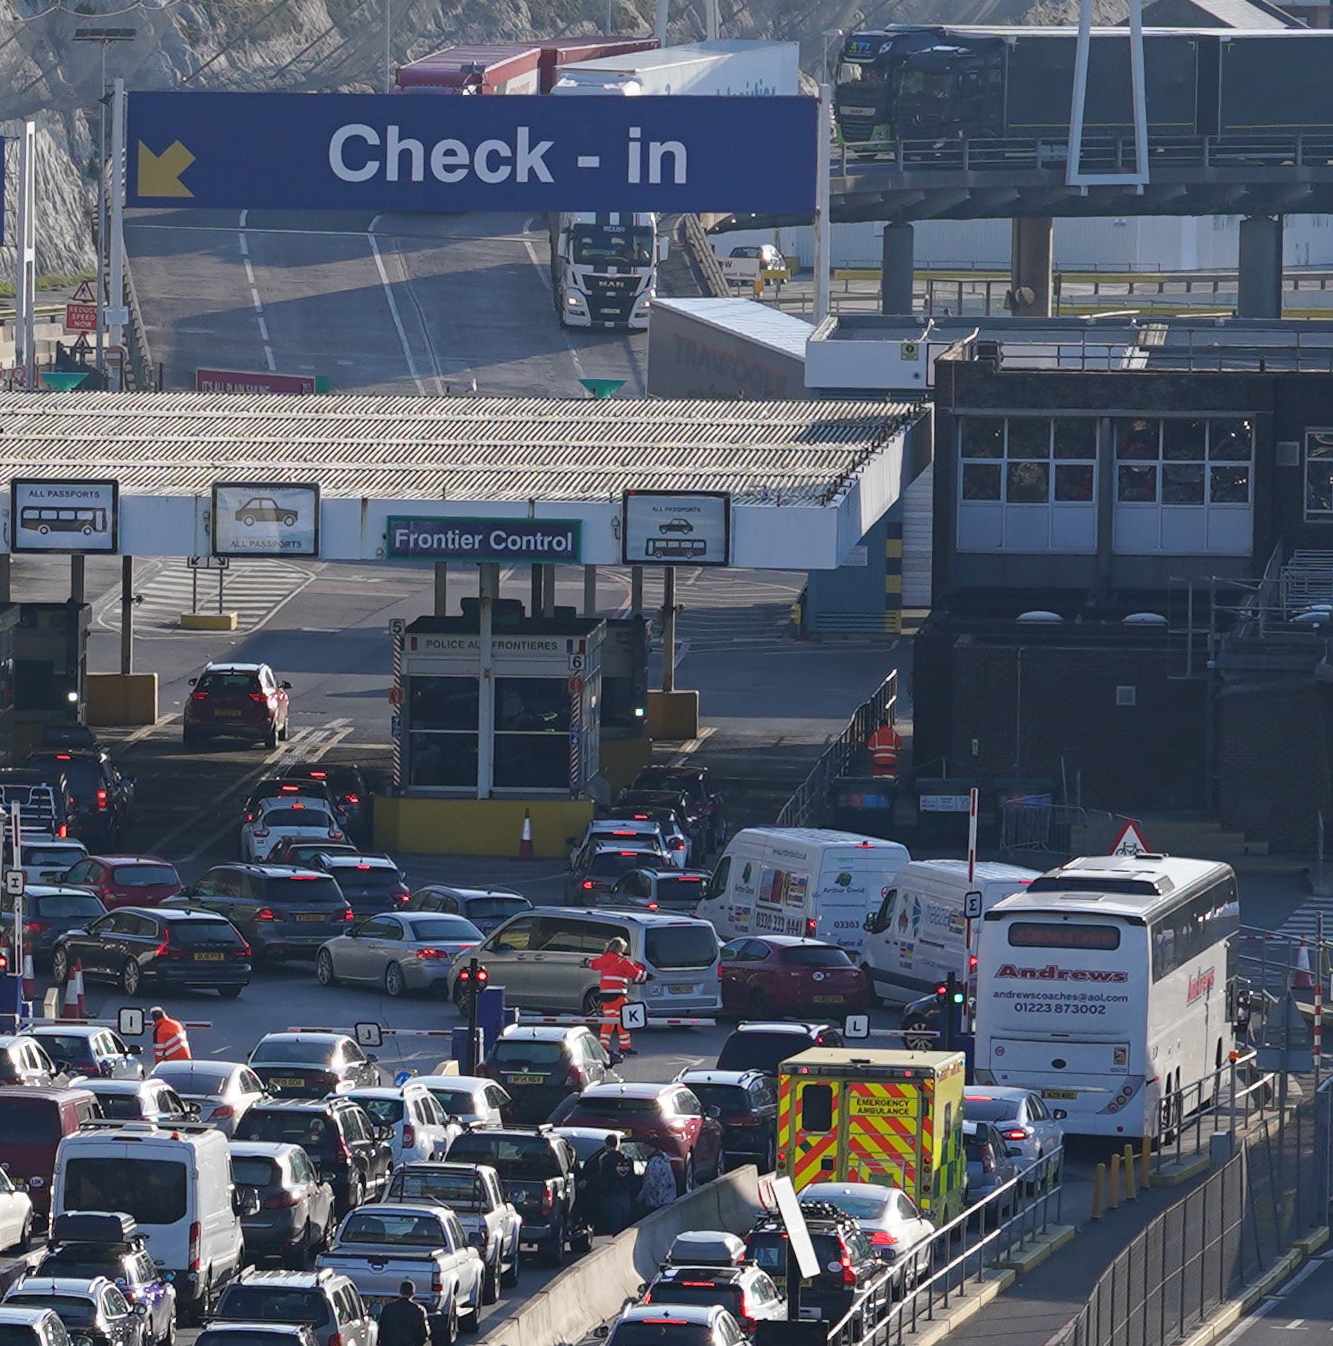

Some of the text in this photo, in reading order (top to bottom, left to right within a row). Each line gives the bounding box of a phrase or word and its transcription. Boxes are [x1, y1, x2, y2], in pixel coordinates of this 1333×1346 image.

[328, 124, 556, 185] Check
[627, 126, 688, 184] in
[29, 490, 100, 499] ALL PASSPORTS
[230, 540, 302, 549] ALL PASSPORTS
[394, 529, 573, 553] Frontier Control
[392, 620, 402, 633] 5
[426, 640, 558, 651] POLICE FRONTIERES
[573, 655, 582, 668] 6
[834, 921, 860, 929] 03303
[992, 964, 1129, 983] Andrews
[992, 991, 1129, 1003] andrewscoaches@aol.com
[1014, 1003, 1107, 1015] 01223 873002
[629, 1010, 638, 1022] K
[853, 1021, 862, 1032] L
[365, 1029, 371, 1040] J
[856, 1098, 909, 1107] EMERGENCY
[856, 1107, 910, 1115] AMBULANCE
